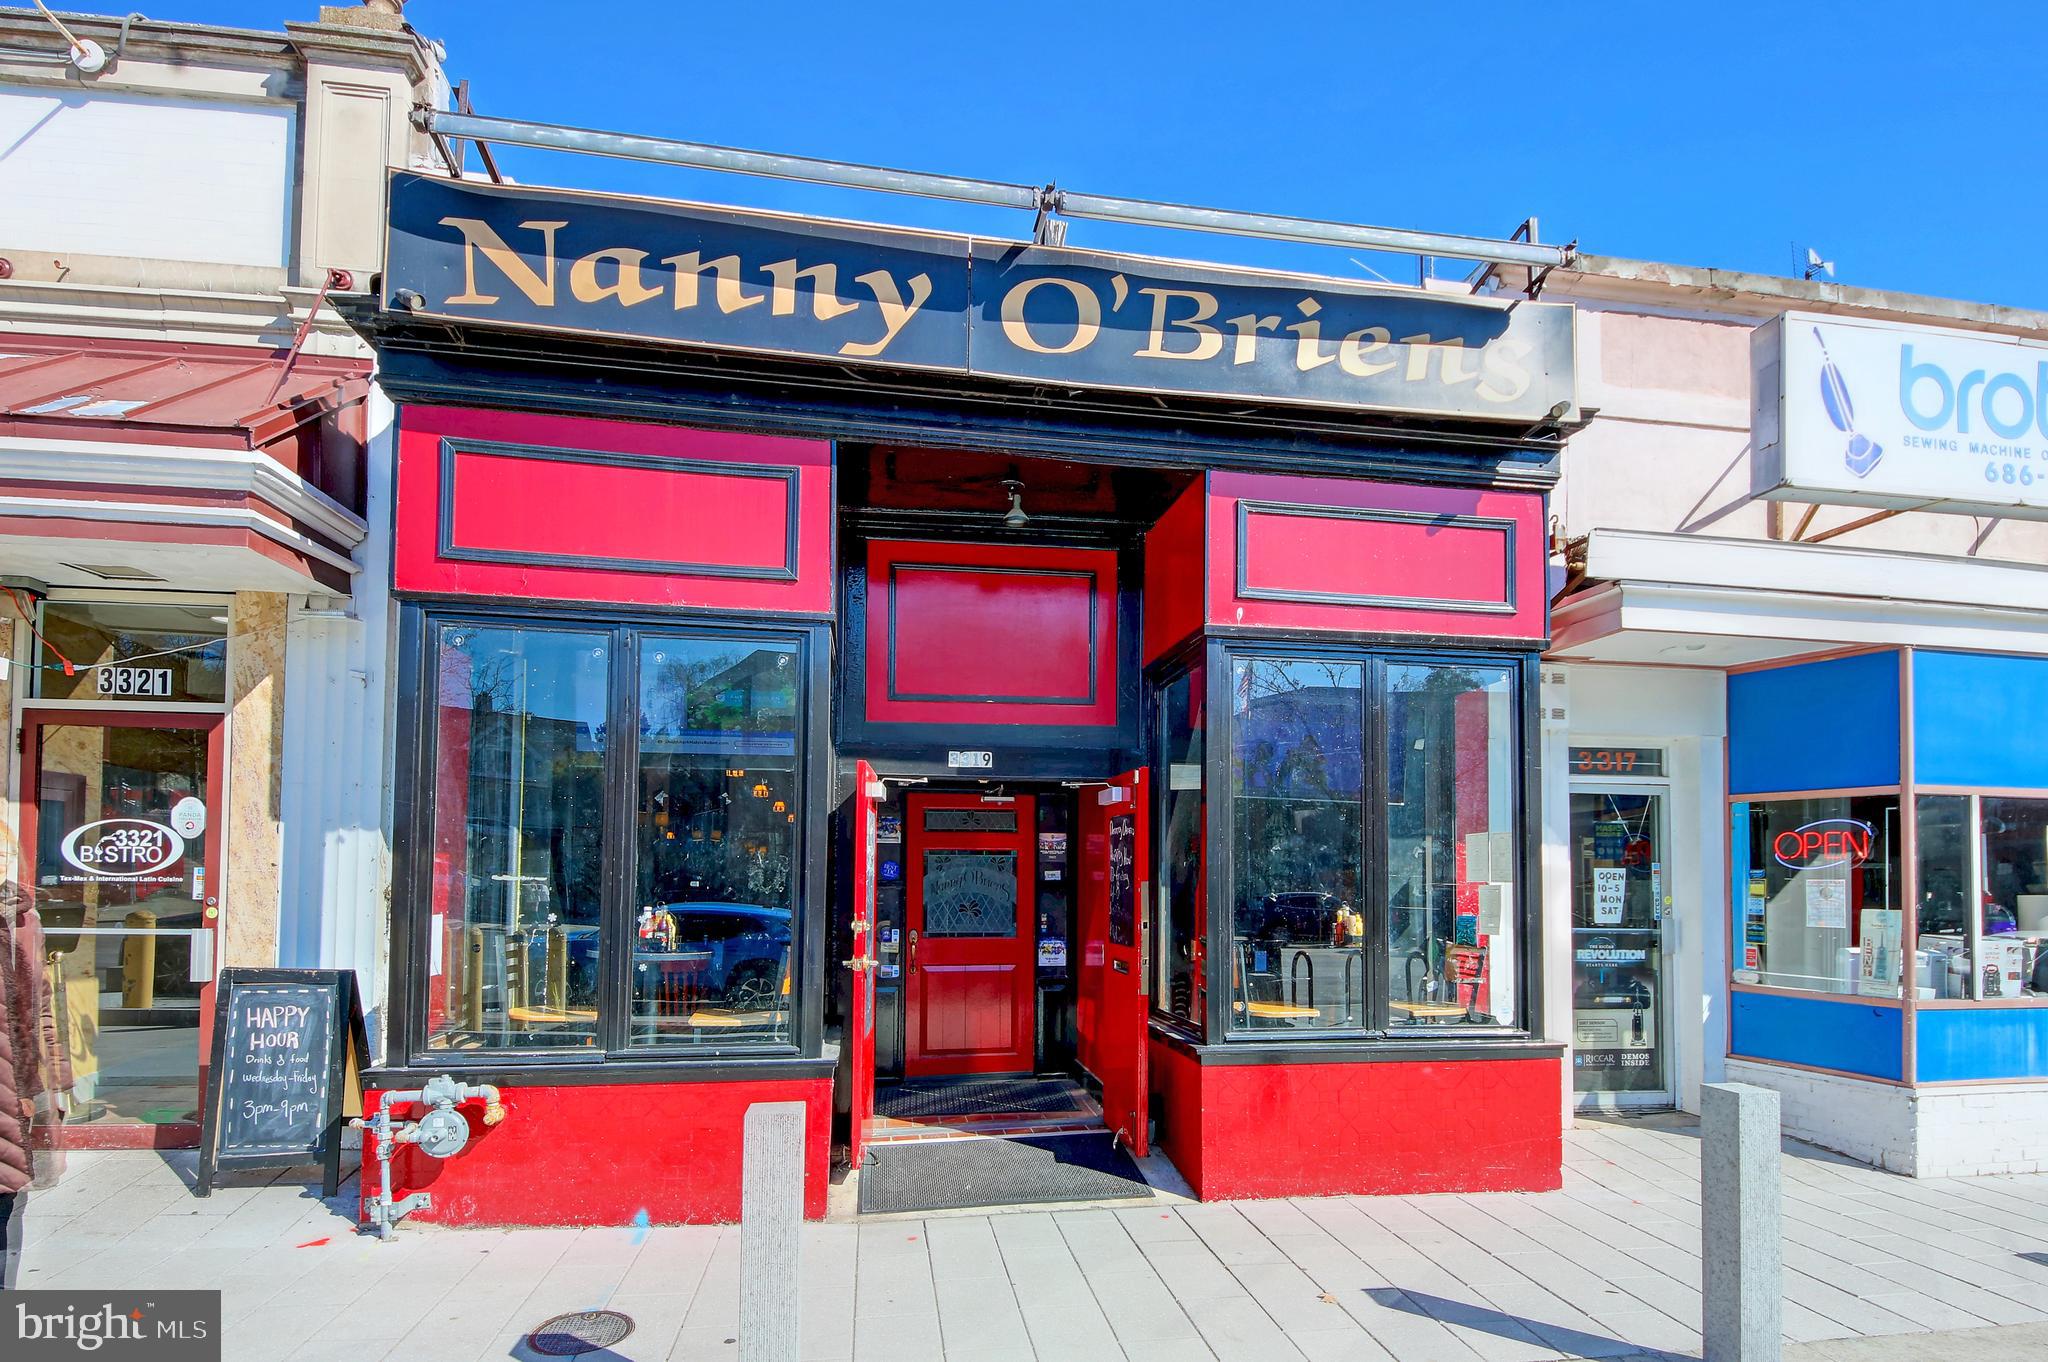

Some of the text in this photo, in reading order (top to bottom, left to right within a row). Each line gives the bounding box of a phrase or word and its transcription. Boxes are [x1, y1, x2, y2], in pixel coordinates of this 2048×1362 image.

[438, 216, 1532, 402] Nanny O'Briens
[1903, 435, 1958, 452] SEWING
[1969, 443, 2032, 459] MACHINE
[99, 668, 171, 694] 3321
[1578, 751, 1638, 772] 3317
[115, 829, 163, 847] 3321
[1774, 831, 1869, 860] OPEN
[1599, 872, 1624, 883] OPEN
[1598, 883, 1620, 892] 10-5
[1600, 895, 1622, 904] MON
[1576, 949, 1646, 960] REVOLUTION
[246, 1005, 310, 1029] HAPPY
[250, 1031, 299, 1051] HOUR
[246, 1053, 273, 1065] Drinks
[1585, 1054, 1615, 1063] RICCAR
